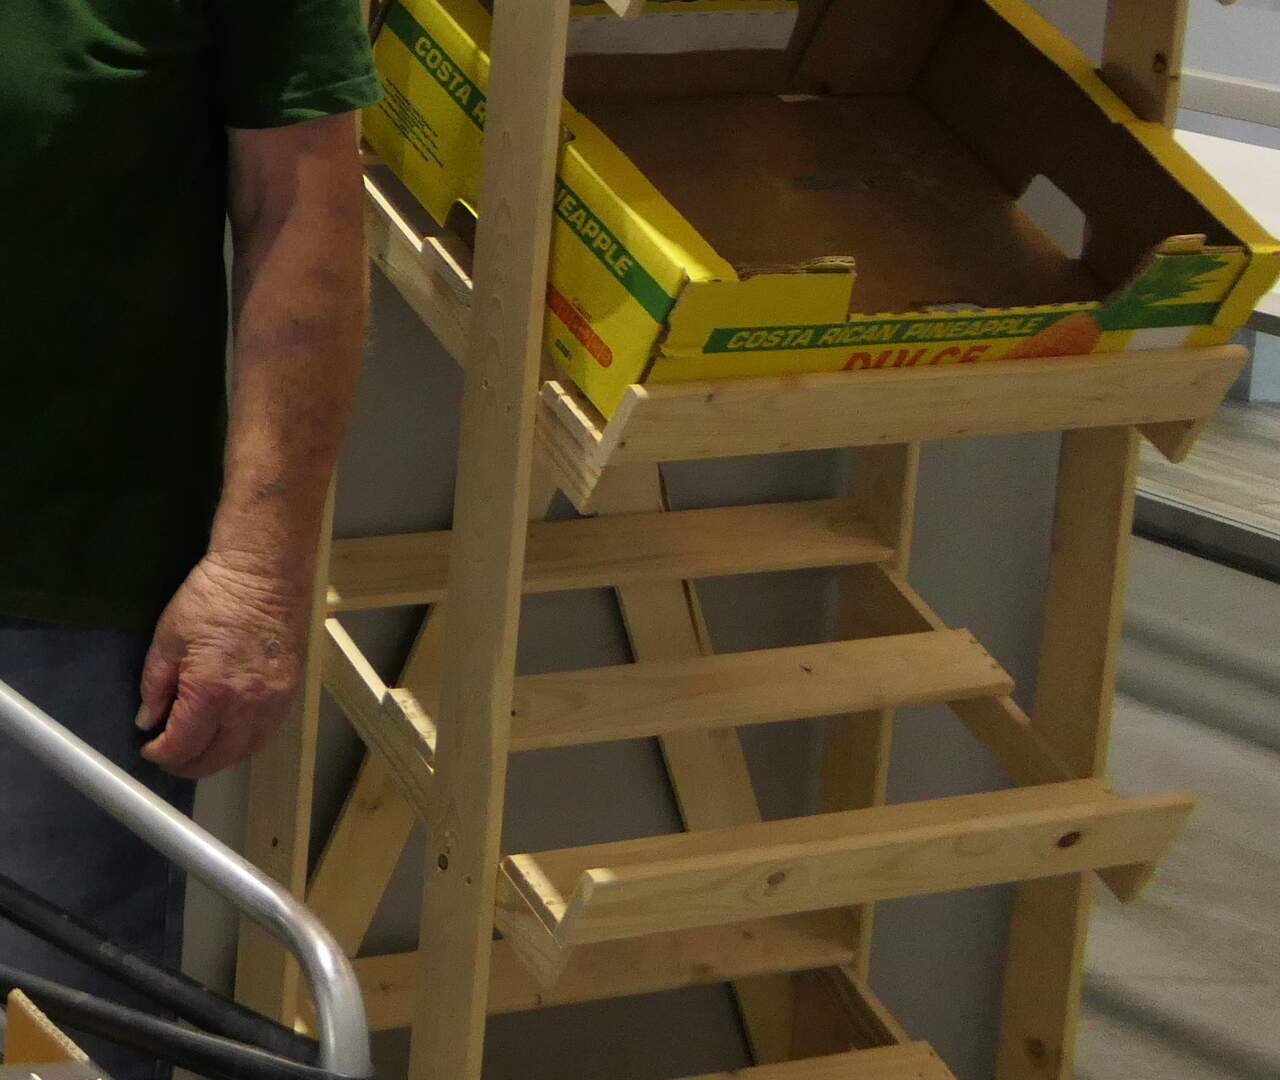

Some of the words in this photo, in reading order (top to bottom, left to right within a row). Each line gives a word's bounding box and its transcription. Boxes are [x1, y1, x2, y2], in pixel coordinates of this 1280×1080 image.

[415, 36, 473, 106] COSTA
[726, 329, 814, 349] COSTA
[817, 322, 901, 346] RICAN
[901, 316, 1045, 341] PINEAPPLE
